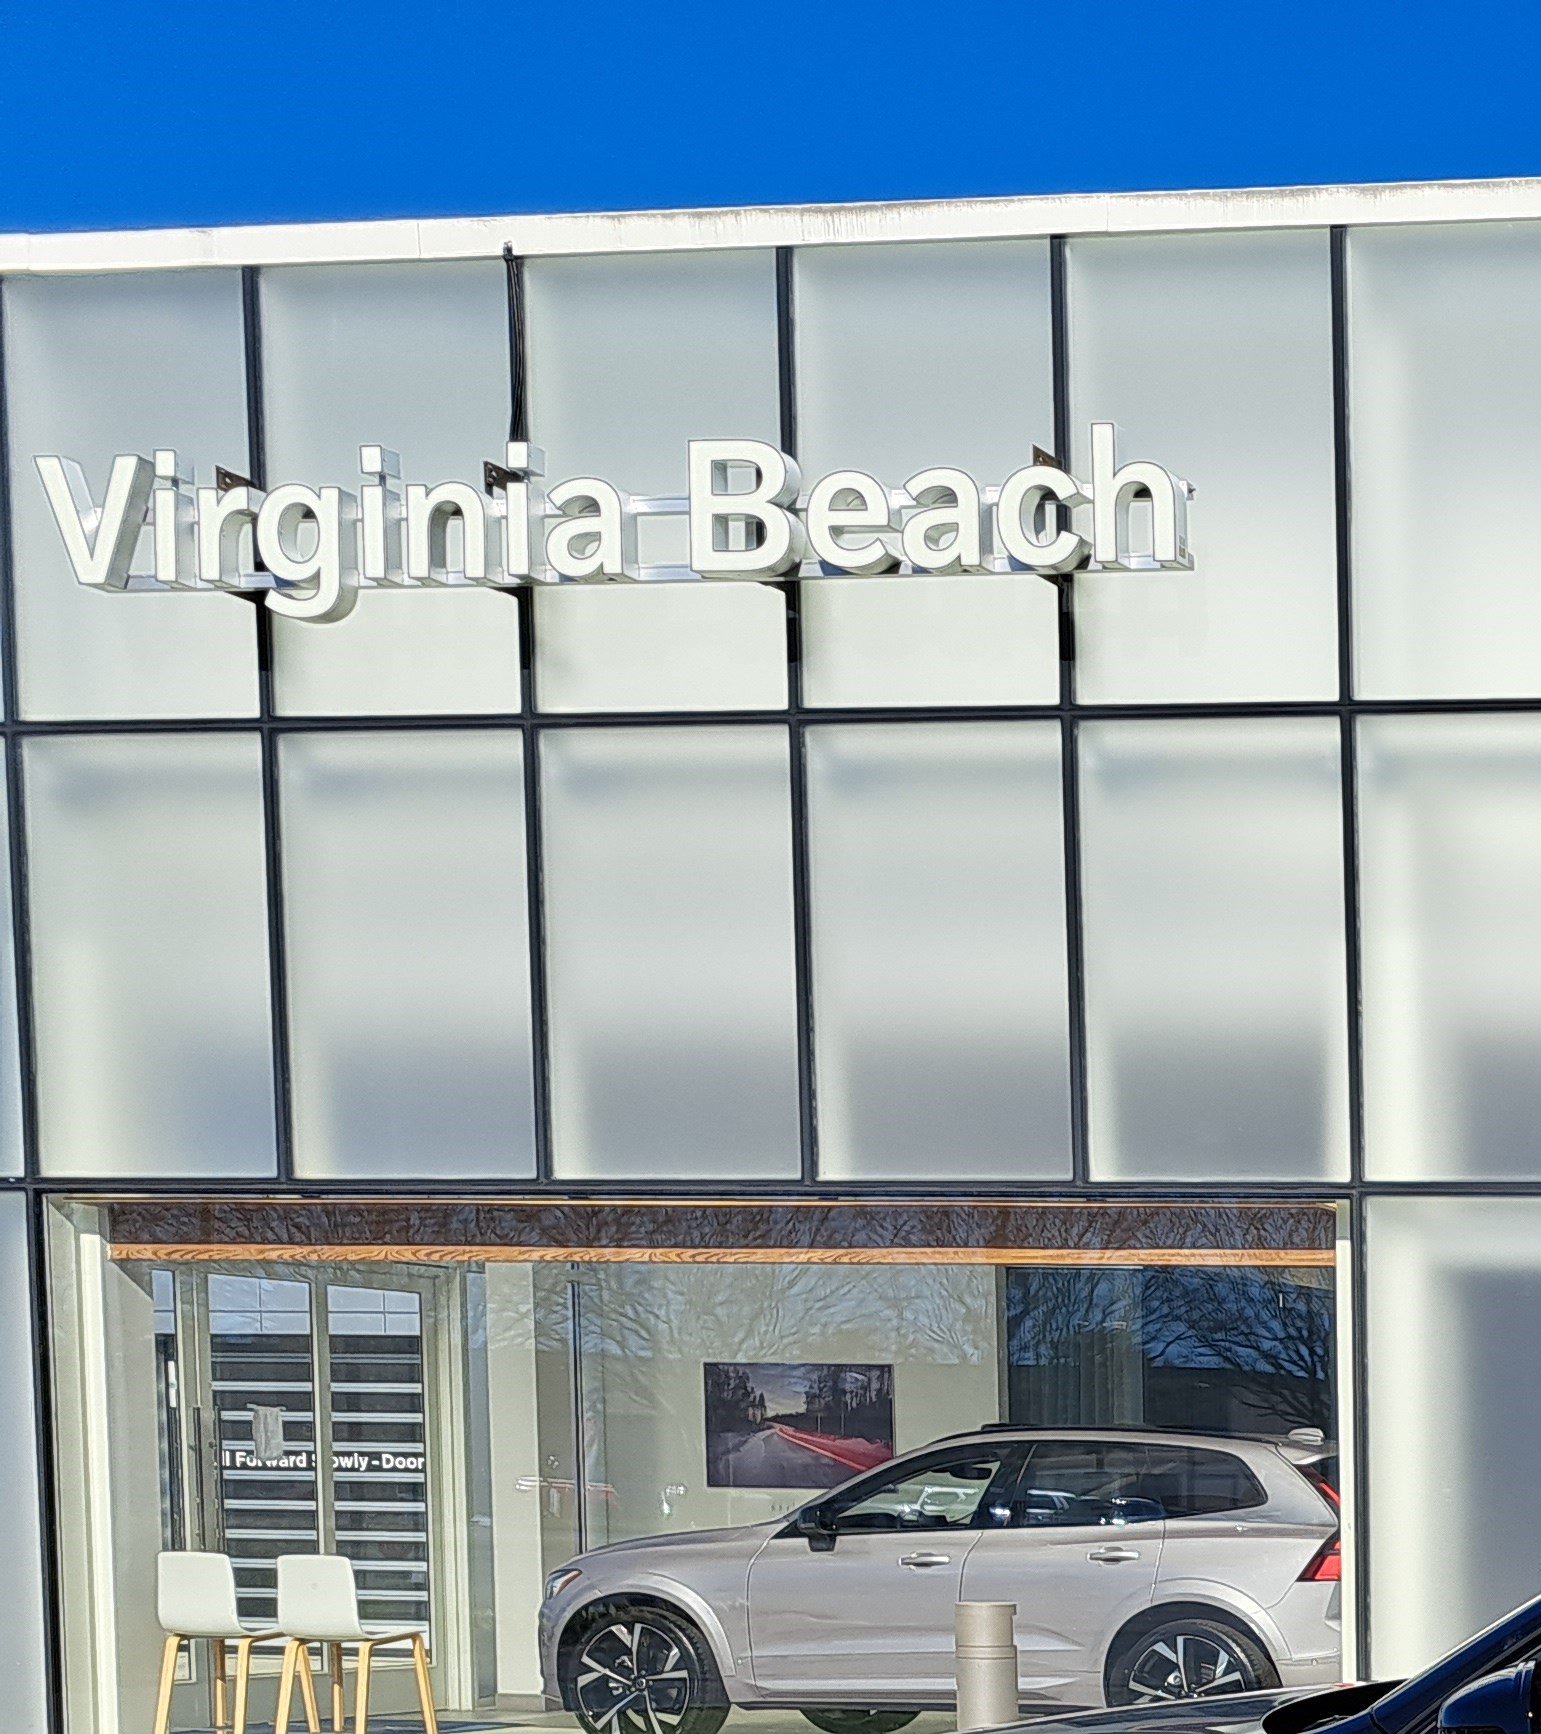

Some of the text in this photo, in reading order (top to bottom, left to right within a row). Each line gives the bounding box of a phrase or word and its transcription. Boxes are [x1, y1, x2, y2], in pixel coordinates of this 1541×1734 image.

[33, 422, 1185, 622] Virginia Beach
[382, 1453, 425, 1470] Door
